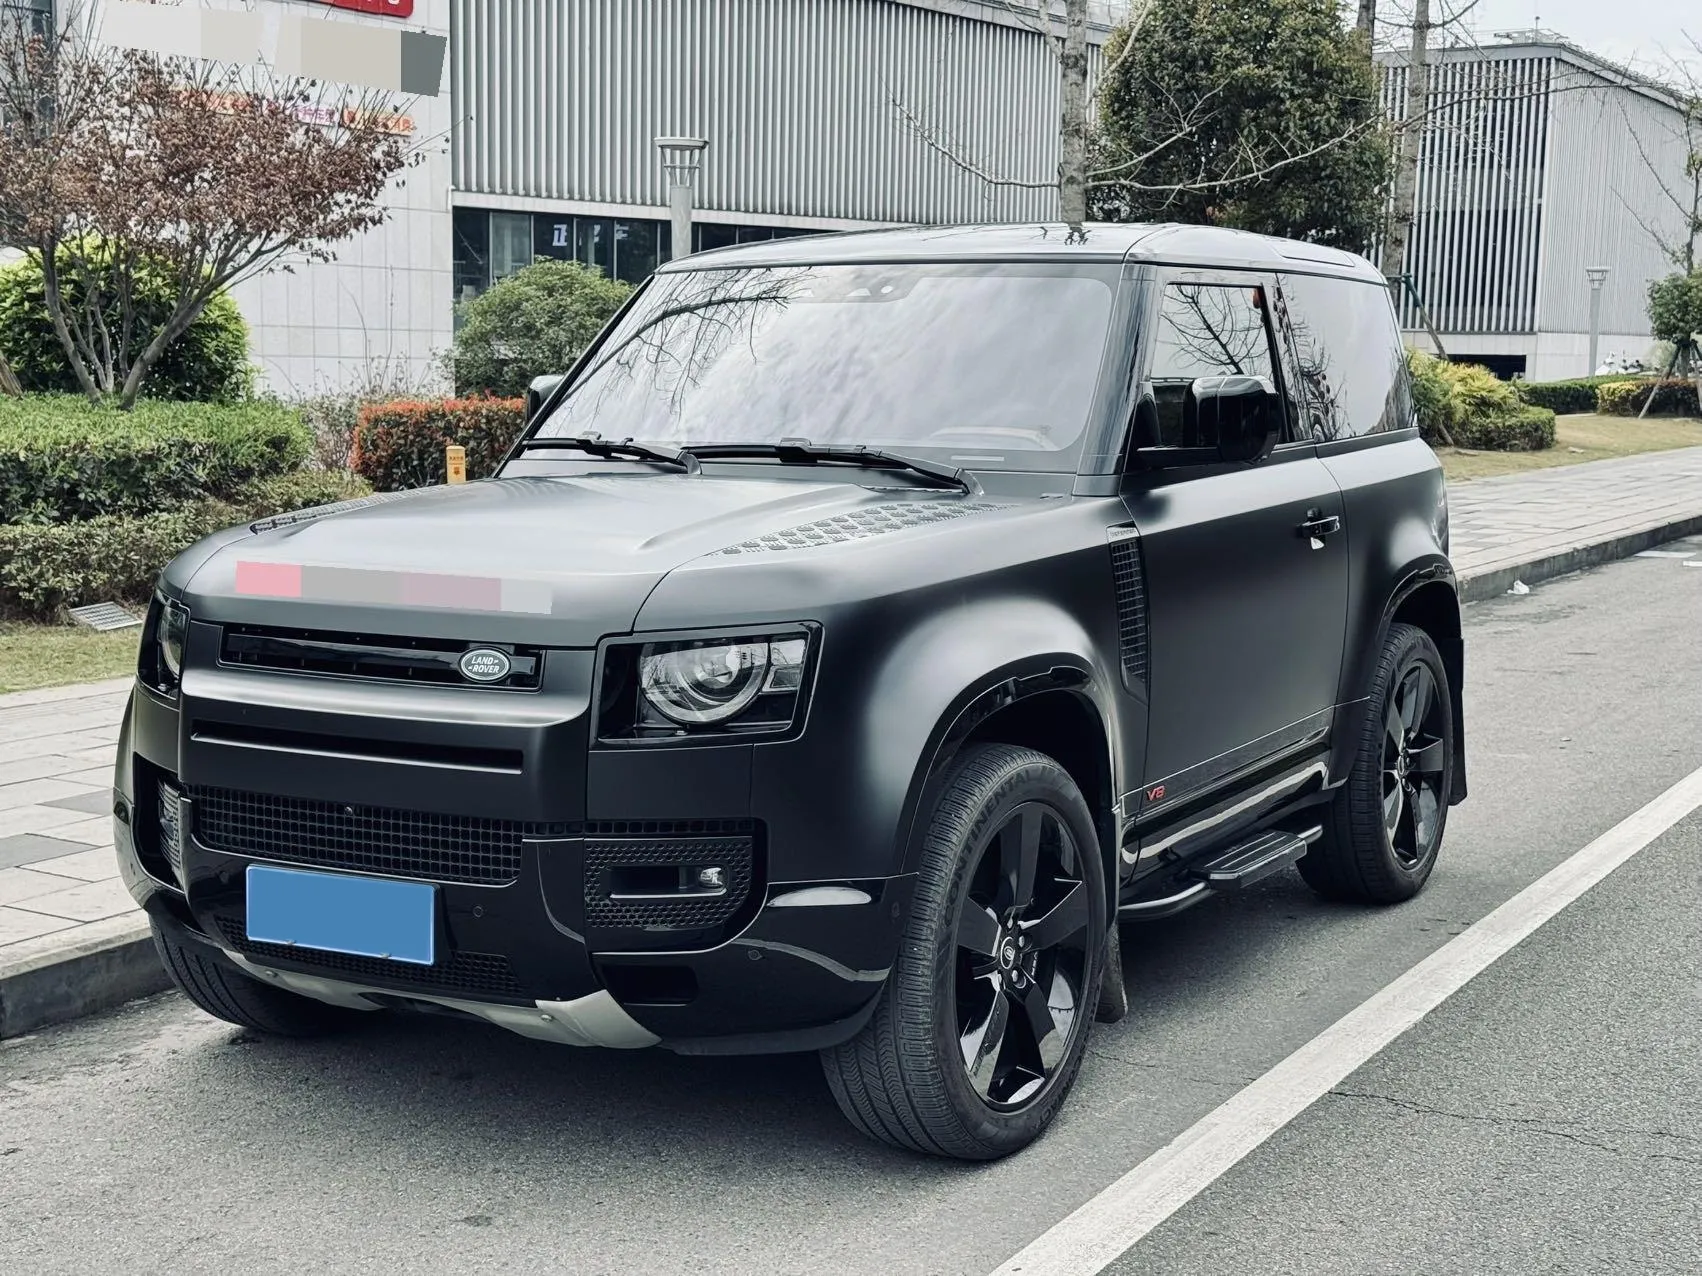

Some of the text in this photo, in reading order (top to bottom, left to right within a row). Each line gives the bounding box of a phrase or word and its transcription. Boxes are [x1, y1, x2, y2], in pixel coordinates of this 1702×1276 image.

[471, 656, 494, 665] LAND
[472, 664, 500, 674] ROVER
[1146, 785, 1165, 801] V8
[945, 768, 1031, 926] CONTINENTAL
